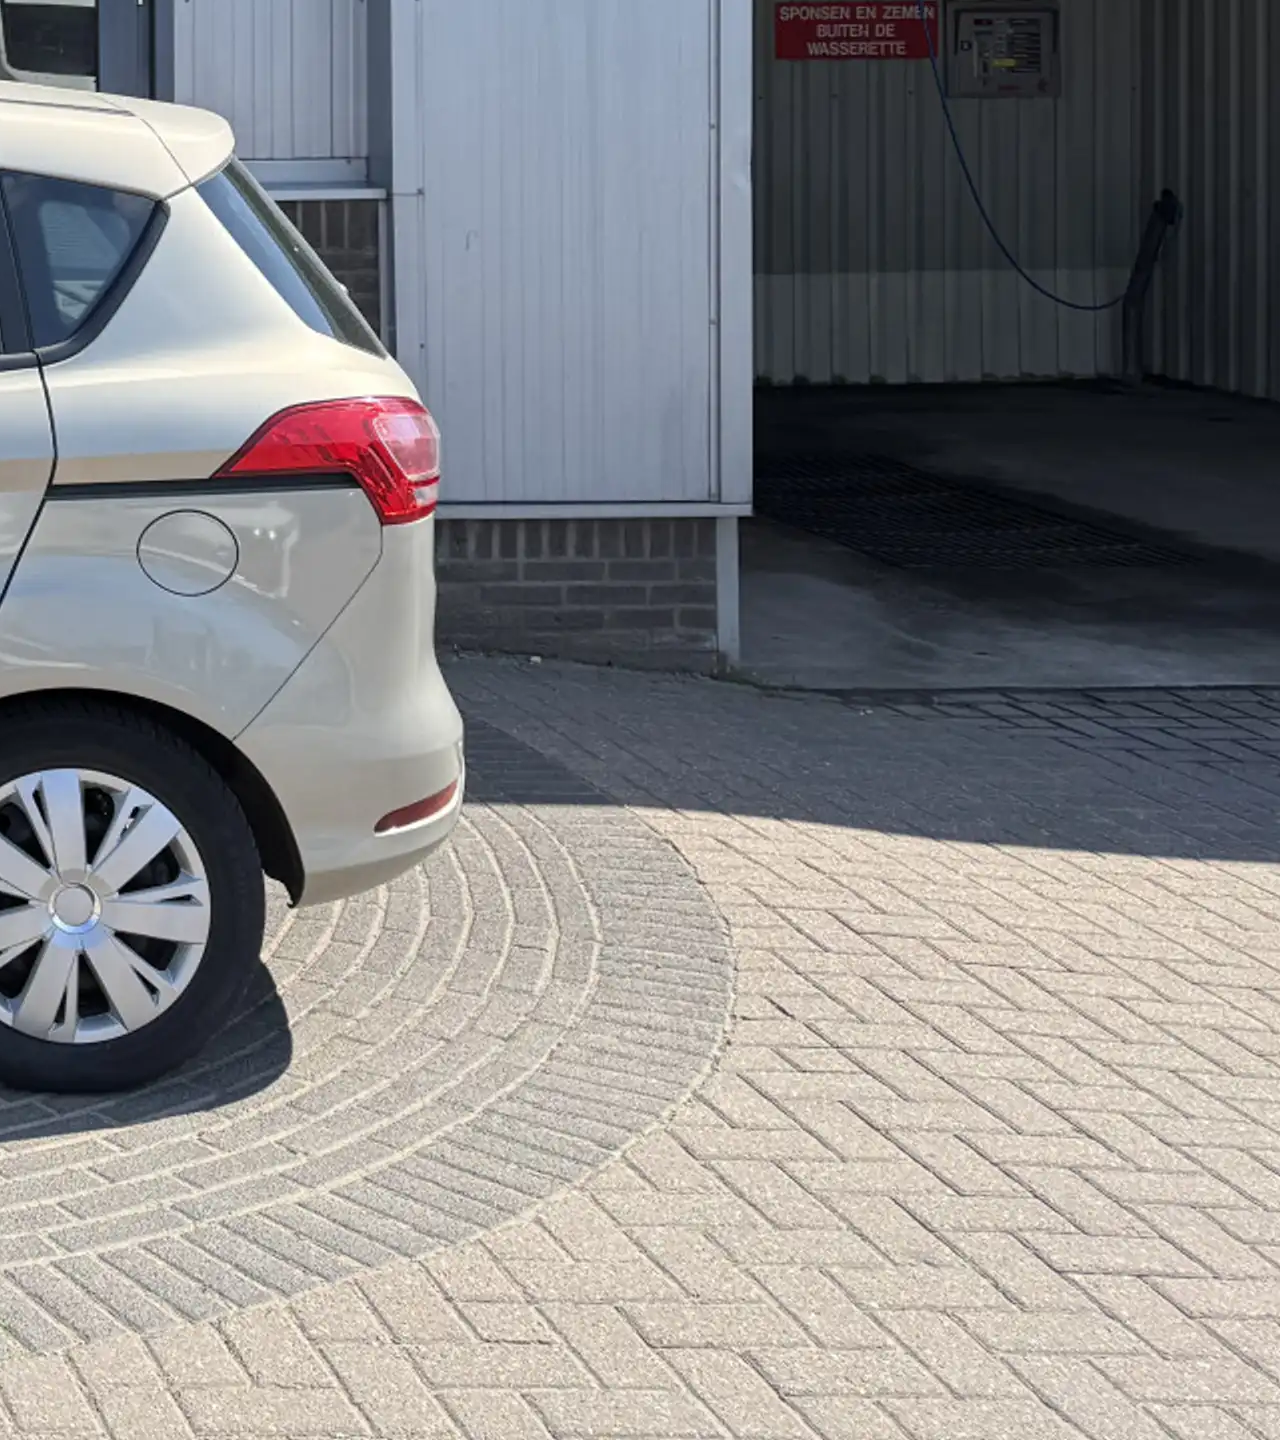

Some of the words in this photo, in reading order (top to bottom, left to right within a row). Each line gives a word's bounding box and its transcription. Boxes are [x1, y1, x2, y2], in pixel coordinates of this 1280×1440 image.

[780, 6, 850, 20] SPONSEN
[856, 6, 877, 19] EN
[883, 6, 934, 19] ZEMEN
[817, 24, 869, 37] BUITEN
[875, 24, 895, 37] DE
[807, 42, 906, 55] WASSERETTE
